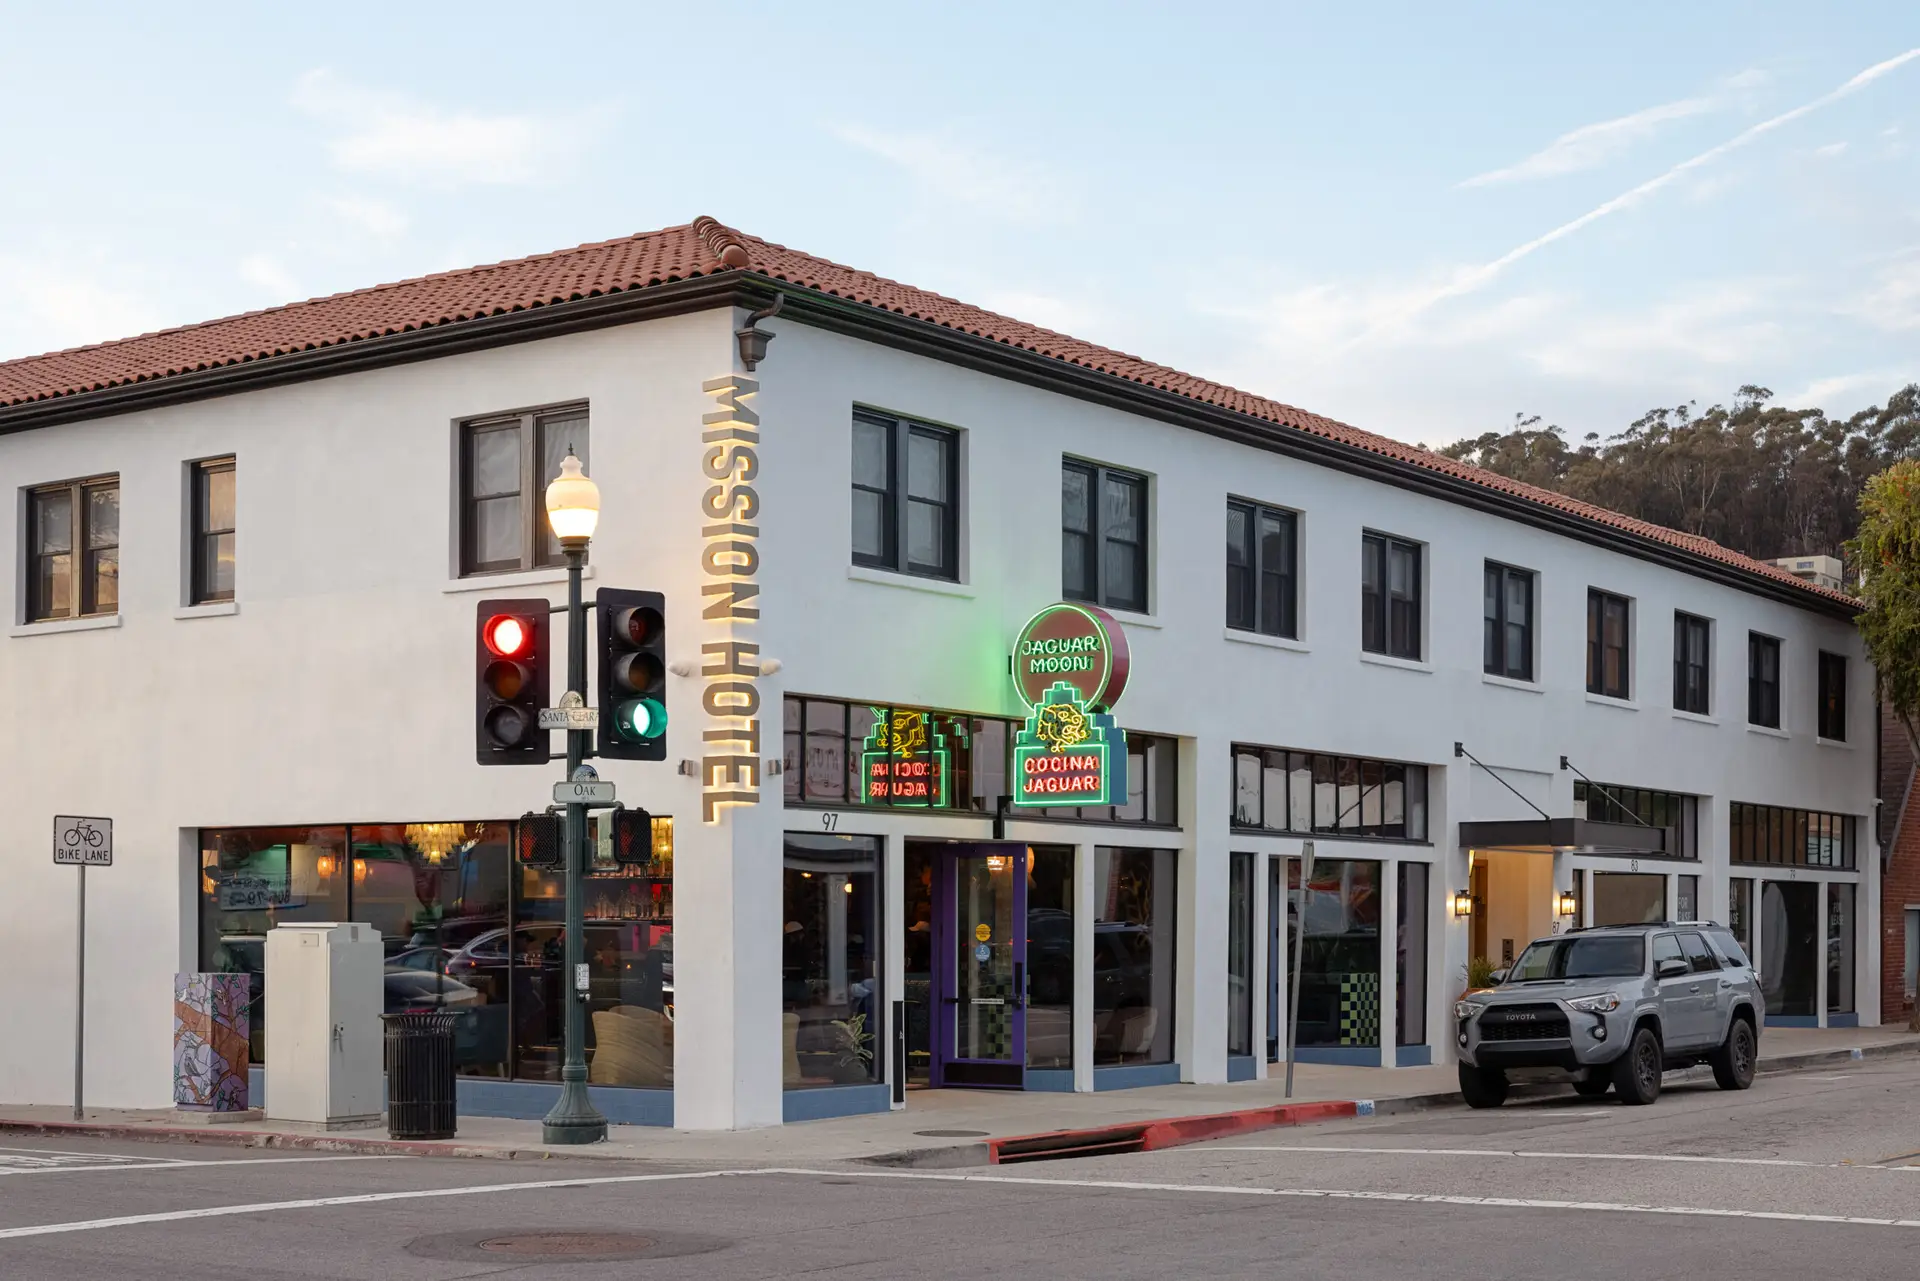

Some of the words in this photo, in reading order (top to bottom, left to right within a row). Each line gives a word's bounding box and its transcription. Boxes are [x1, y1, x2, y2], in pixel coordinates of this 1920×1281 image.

[702, 375, 760, 621] MISSION
[1022, 636, 1098, 656] JAGUAR
[1029, 656, 1092, 674] MOON
[541, 711, 569, 722] SANTA
[701, 641, 760, 823] HOTEL
[1024, 756, 1099, 773] COCINA
[574, 783, 596, 796] OAK
[1023, 776, 1099, 792] JAGUAR
[822, 812, 838, 831] 97
[58, 848, 80, 860] BIKE
[85, 850, 108, 861] LANE
[1630, 859, 1638, 872] 83
[1552, 922, 1560, 934] 87
[1506, 1013, 1536, 1021] TOYOTA
